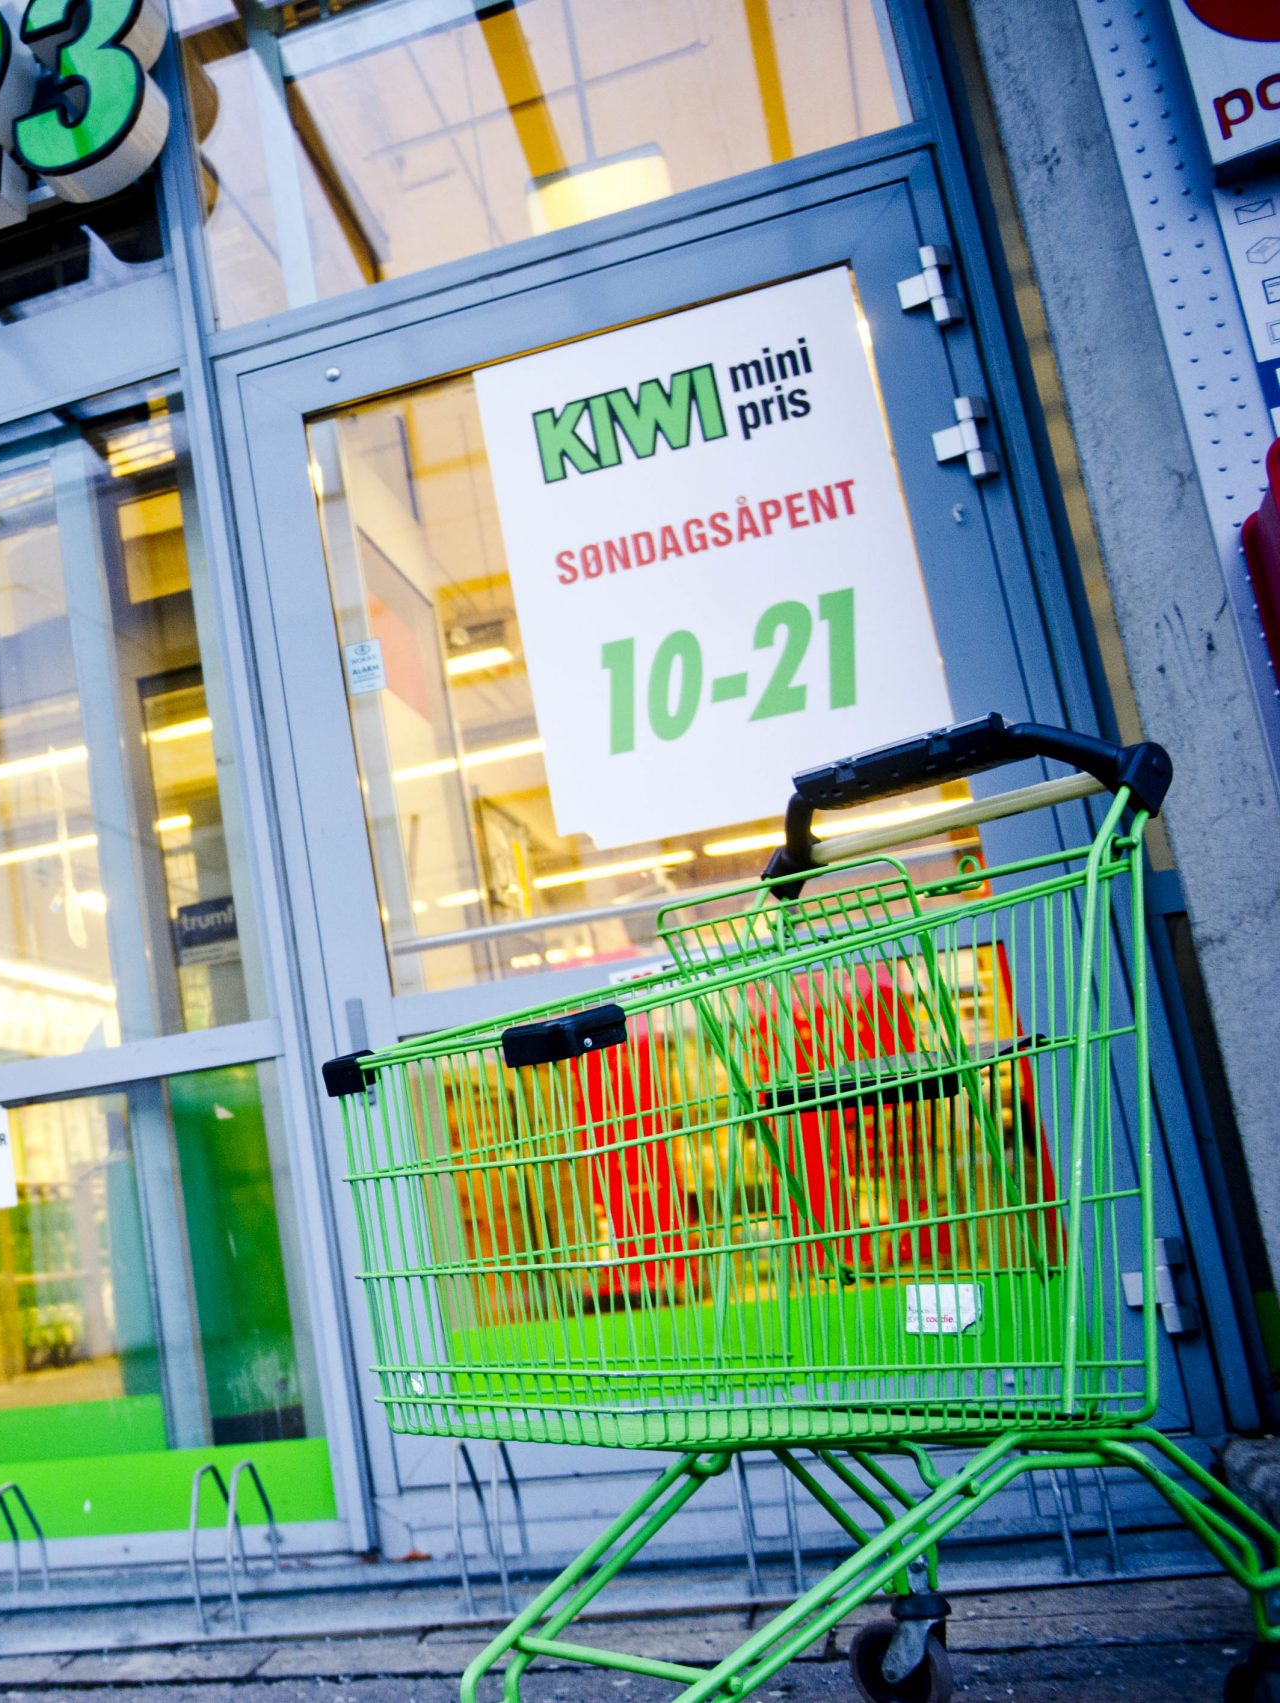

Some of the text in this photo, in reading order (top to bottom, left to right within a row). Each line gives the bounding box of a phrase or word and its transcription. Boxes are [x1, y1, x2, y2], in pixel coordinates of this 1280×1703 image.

[729, 337, 813, 393] mini
[737, 386, 812, 441] pris
[531, 362, 728, 484] KIWI
[554, 479, 857, 586] SØNDAGSÅPENT
[600, 586, 858, 756] 10-21
